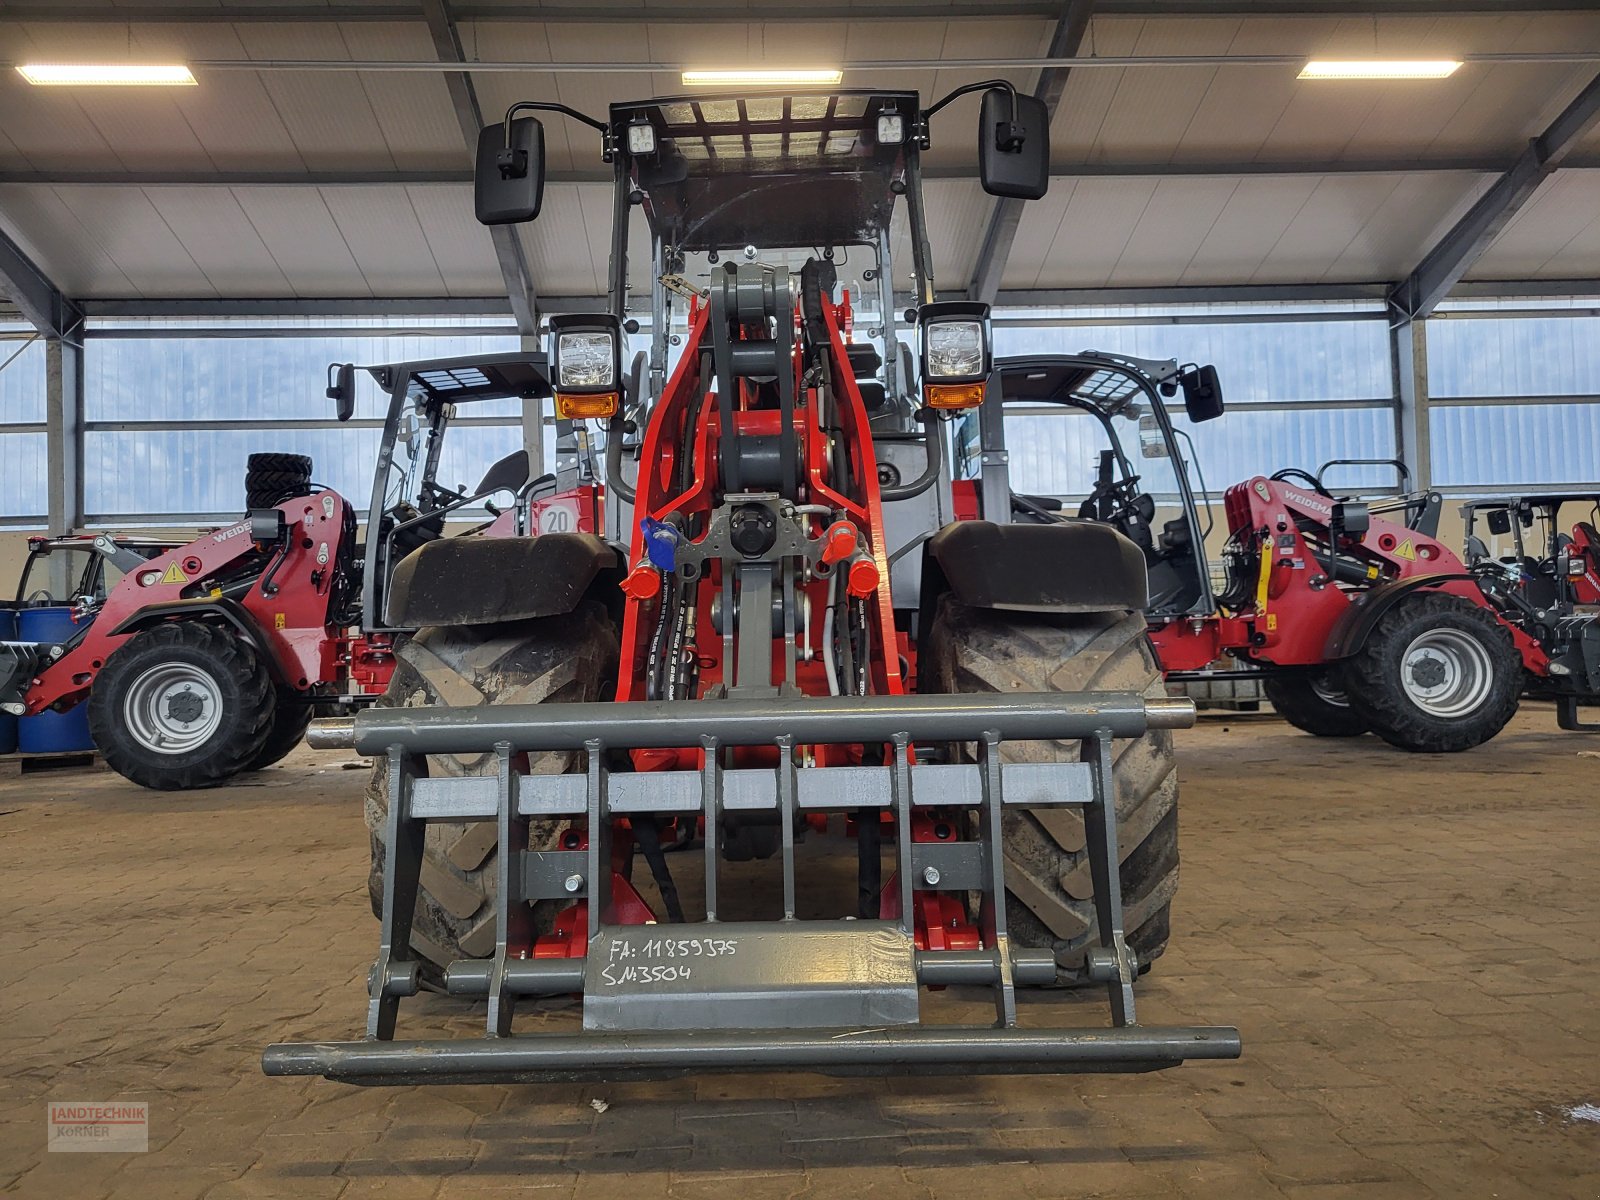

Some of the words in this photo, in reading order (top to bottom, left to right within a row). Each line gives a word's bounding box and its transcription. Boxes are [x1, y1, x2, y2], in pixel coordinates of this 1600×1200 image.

[212, 520, 253, 543] WEIDE
[547, 511, 568, 533] 20
[609, 939, 636, 962] FA:
[642, 938, 738, 958] 11859375
